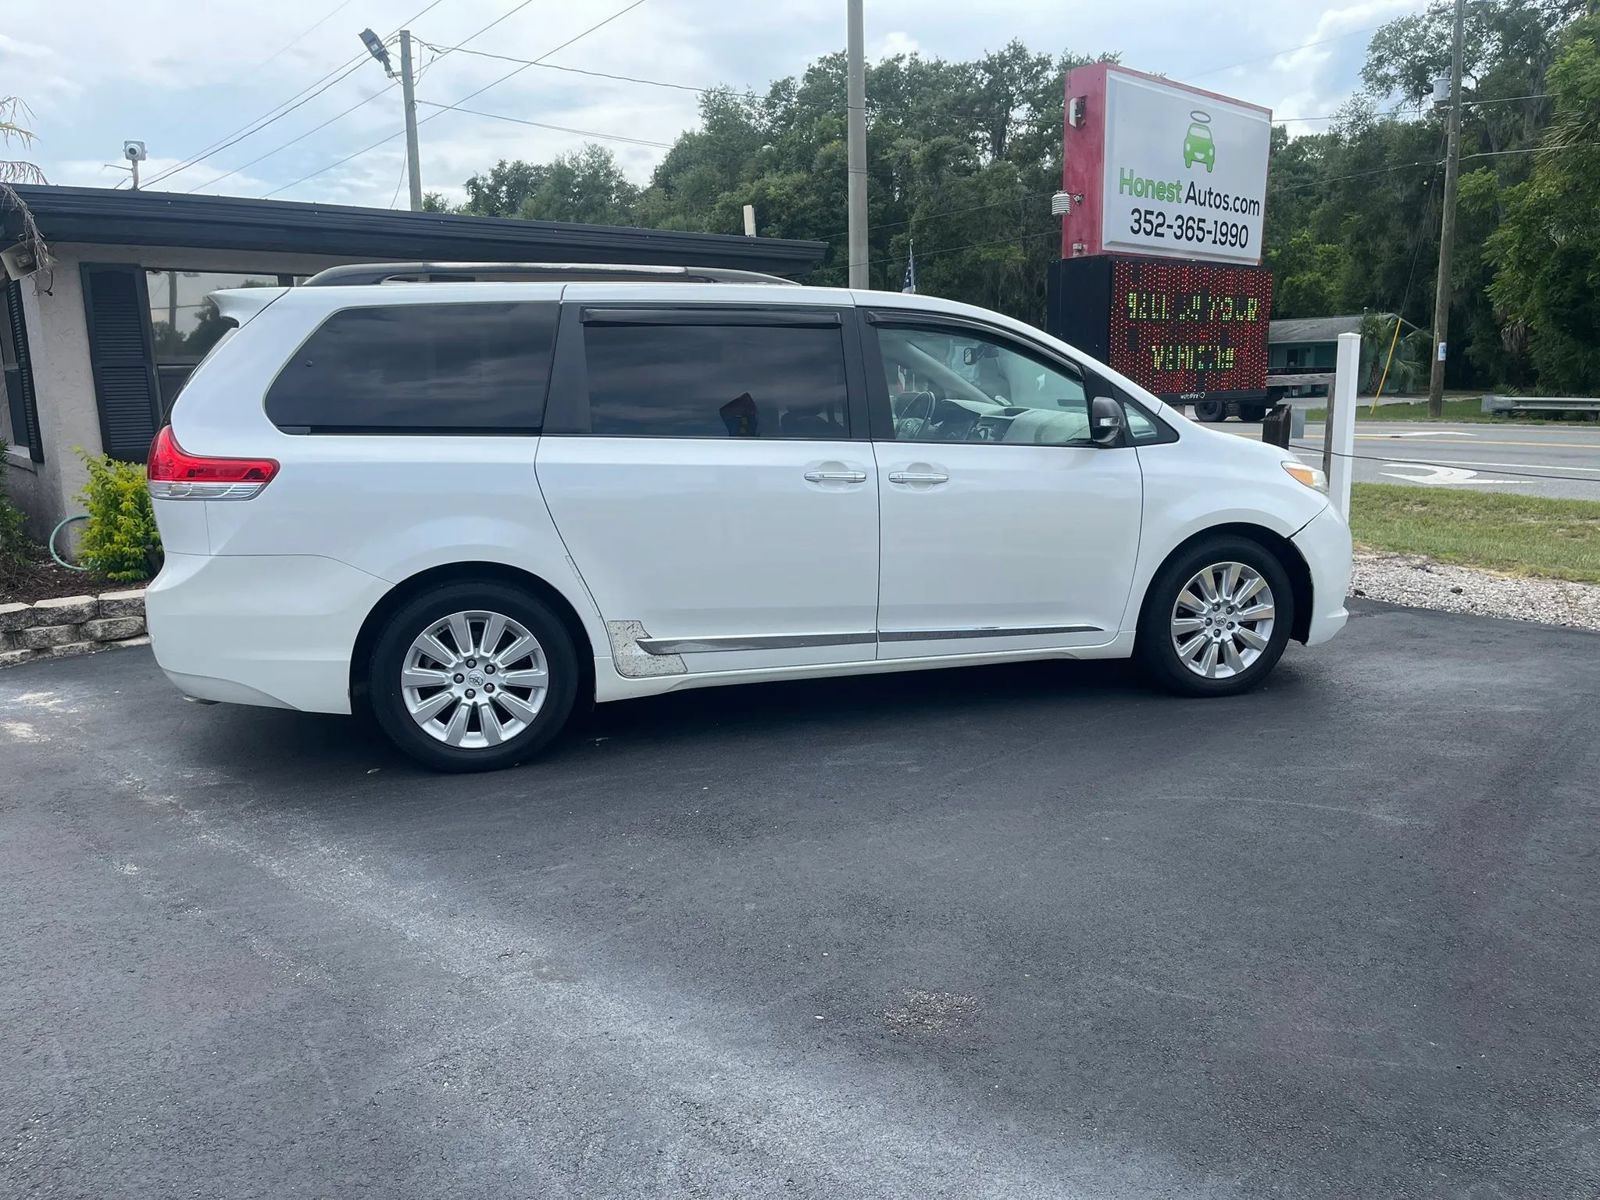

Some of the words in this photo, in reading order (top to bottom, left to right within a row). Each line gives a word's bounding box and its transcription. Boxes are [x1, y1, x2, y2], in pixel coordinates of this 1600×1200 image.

[1119, 167, 1183, 204] Honest
[1184, 181, 1260, 217] Autos.com
[1130, 208, 1249, 249] 352-365-1990
